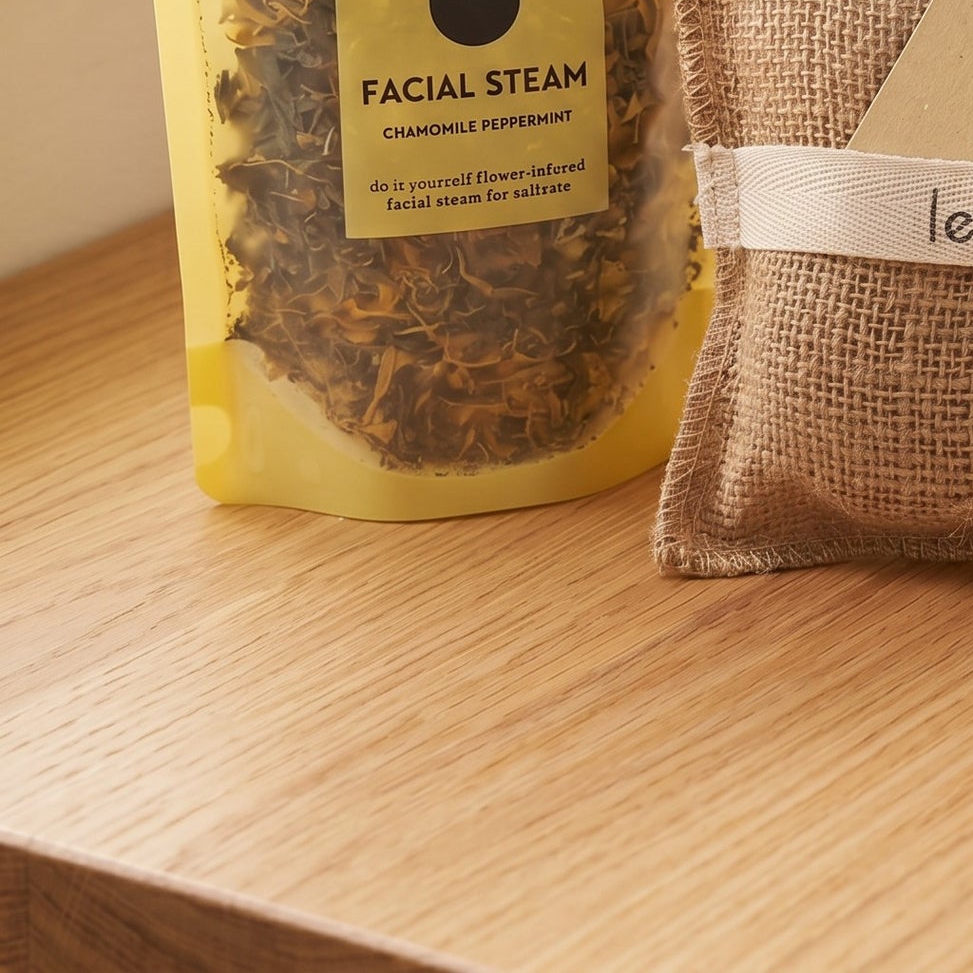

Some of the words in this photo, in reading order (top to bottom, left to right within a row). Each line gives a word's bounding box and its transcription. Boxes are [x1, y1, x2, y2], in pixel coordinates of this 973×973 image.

[362, 73, 475, 105] FACIAL
[486, 61, 587, 96] STEAM
[383, 120, 477, 140] CHAMOMILE
[482, 110, 572, 132] PEPPERMINT
[370, 180, 389, 193] do
[387, 195, 431, 211] facial
[436, 194, 482, 208] steam
[487, 189, 509, 202] for
